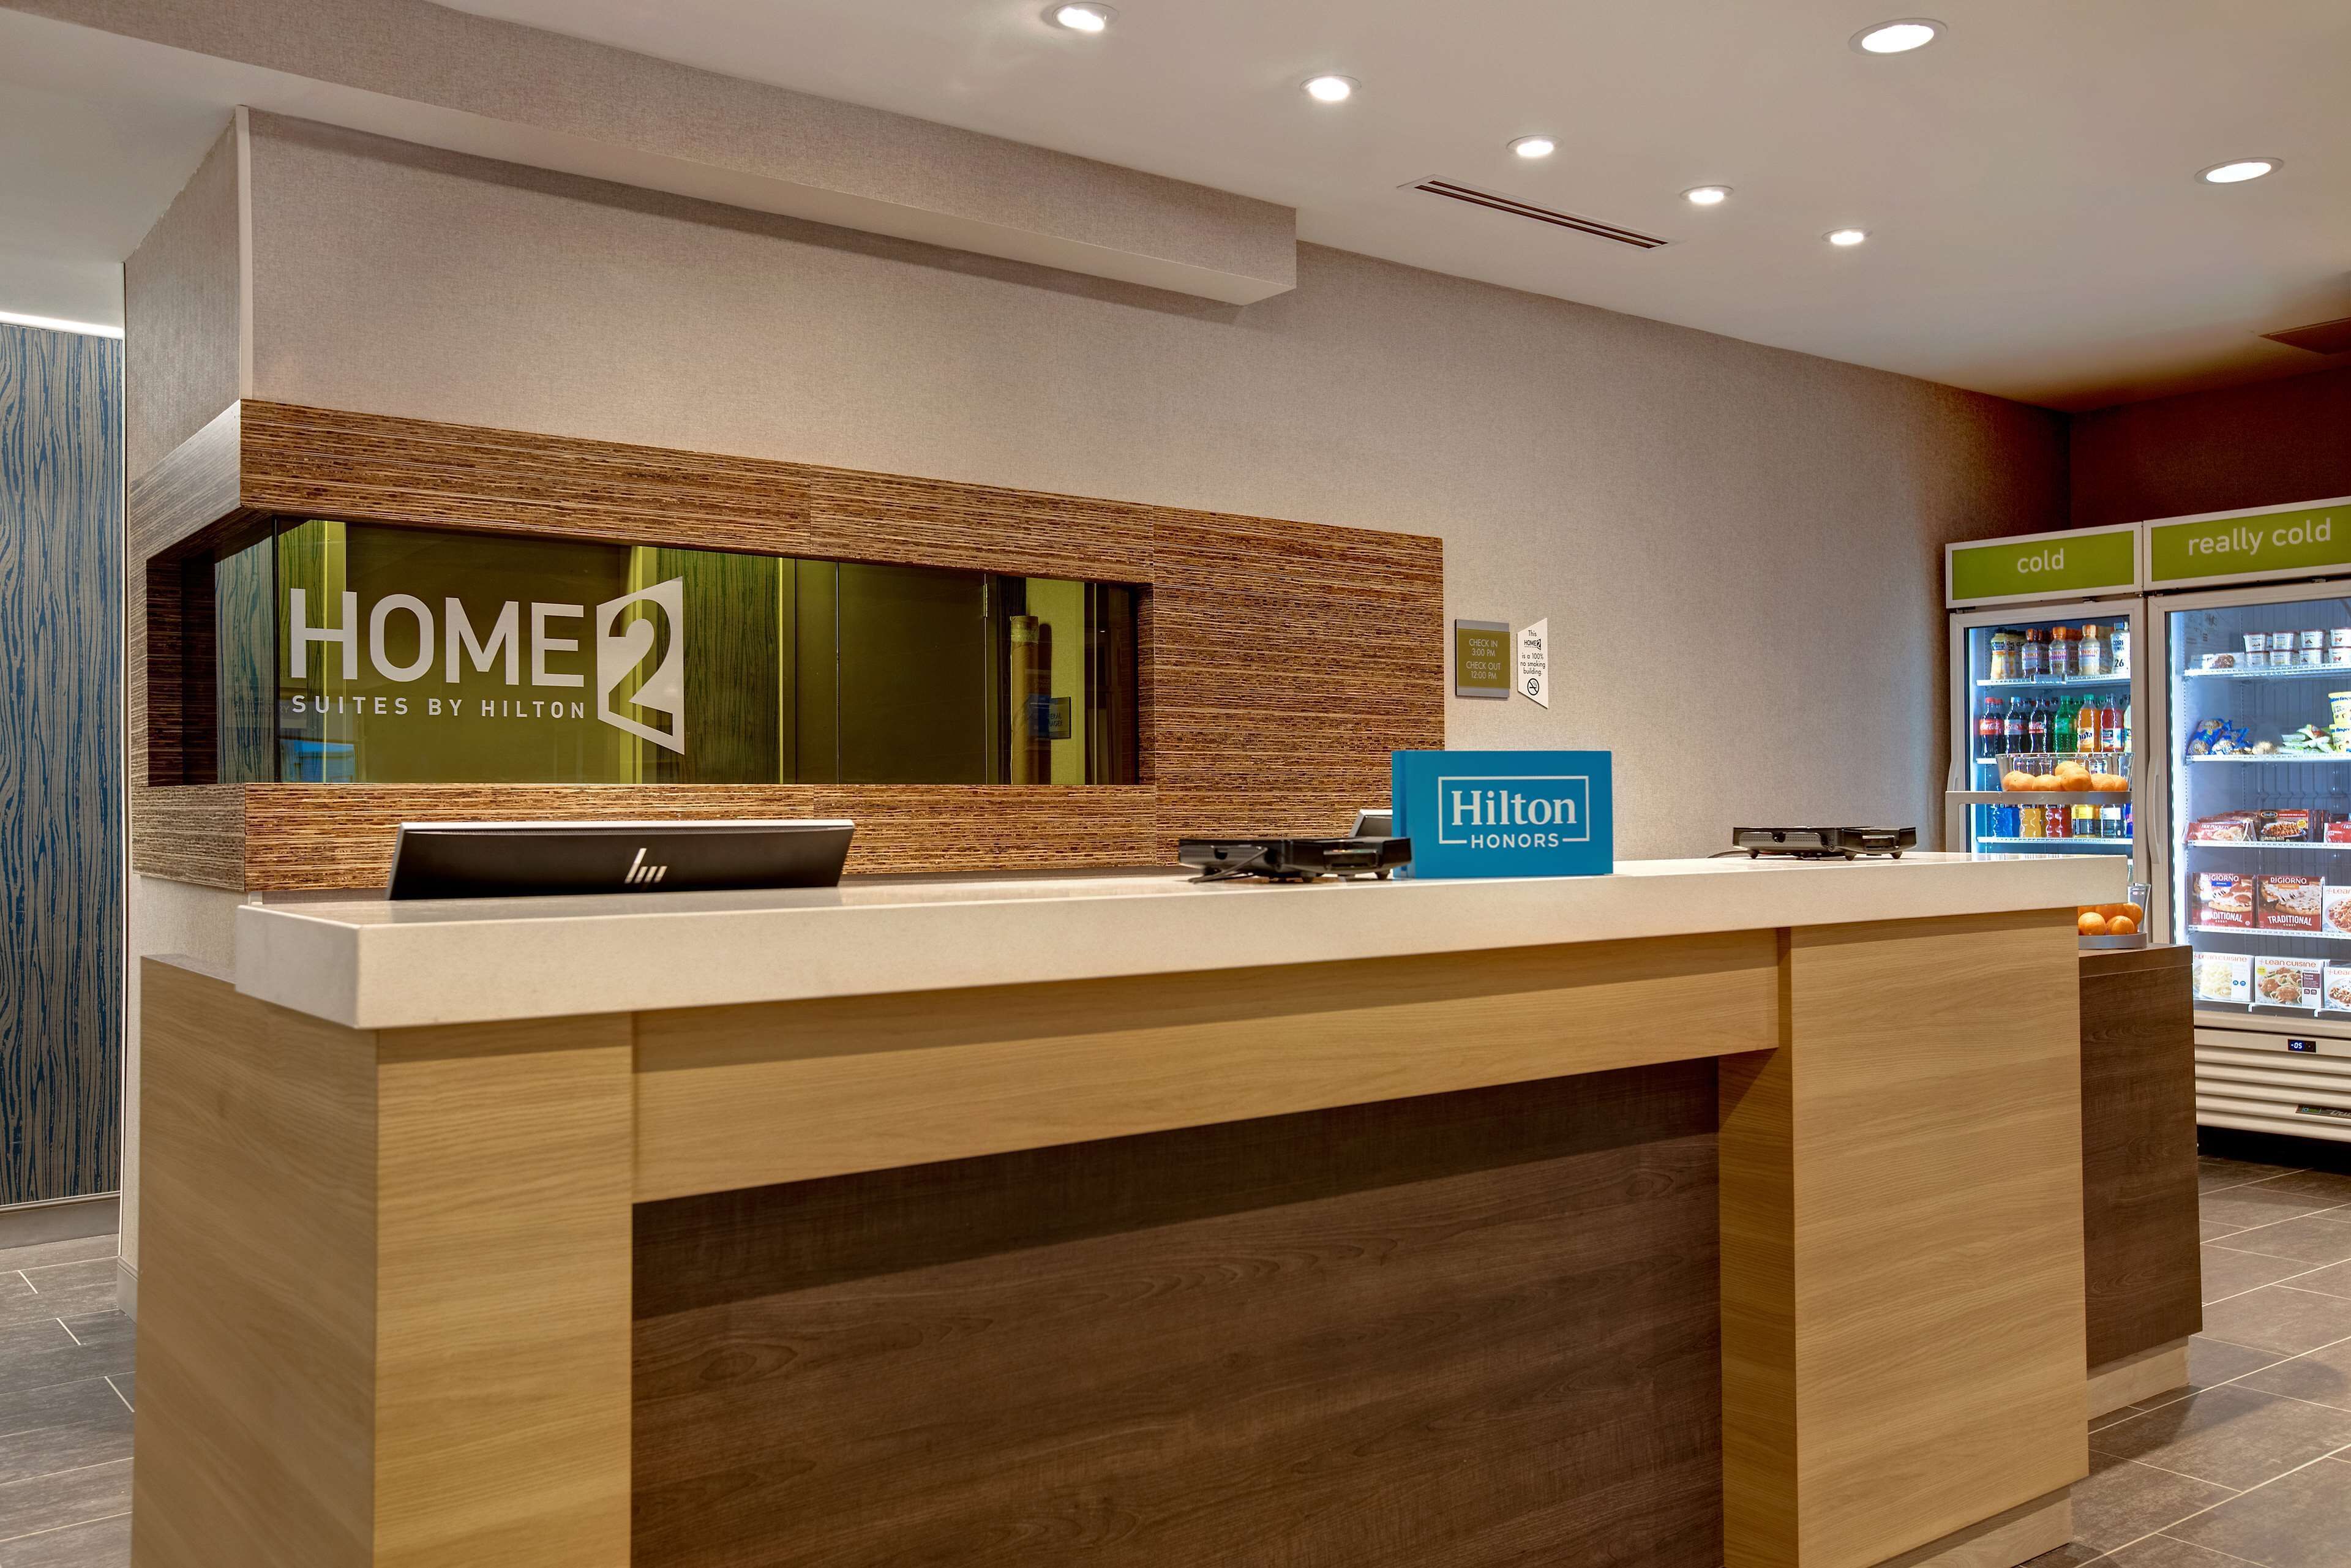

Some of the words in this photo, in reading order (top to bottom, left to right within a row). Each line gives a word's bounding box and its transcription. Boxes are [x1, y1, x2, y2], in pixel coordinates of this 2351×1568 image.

[2188, 528, 2263, 556] really
[2272, 517, 2331, 547] cold
[2017, 549, 2064, 573] cold
[1469, 638, 1490, 647] CHECK
[1472, 648, 1485, 656] 3:00
[1466, 661, 1487, 670] CHECK
[1488, 662, 1501, 670] OUT
[1528, 660, 1546, 669] smoking
[2115, 659, 2124, 667] 26
[1471, 670, 1487, 679] 12:00
[1523, 667, 1543, 677] building.
[292, 695, 408, 715] SUITES
[429, 698, 463, 716] BY
[482, 700, 584, 719] HILTON
[1451, 790, 1577, 826] Hilton
[1471, 833, 1559, 849] HONORS
[2201, 910, 2243, 923] ADITIONAL
[2267, 915, 2312, 926] TRADITIONAL
